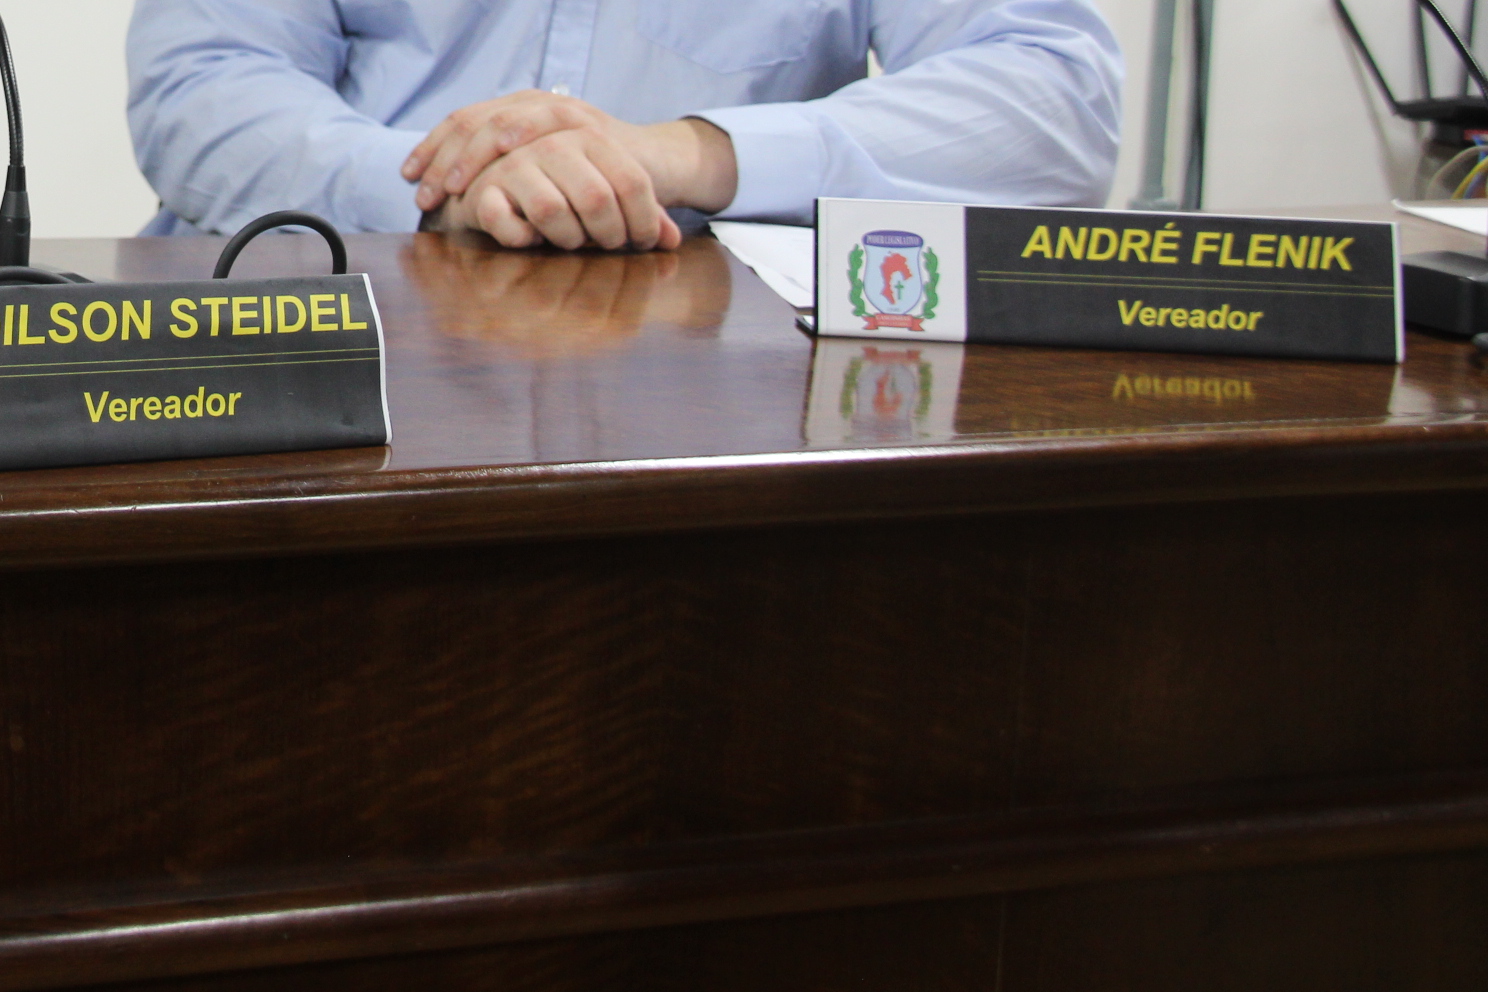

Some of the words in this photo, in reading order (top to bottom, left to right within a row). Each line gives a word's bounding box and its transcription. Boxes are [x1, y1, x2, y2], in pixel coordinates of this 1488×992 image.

[1020, 221, 1182, 264] ANDRÉ
[1191, 231, 1355, 271] FLENIK
[168, 293, 369, 339] STEIDEL
[1117, 300, 1264, 331] Vereador
[83, 386, 243, 423] Vereador
